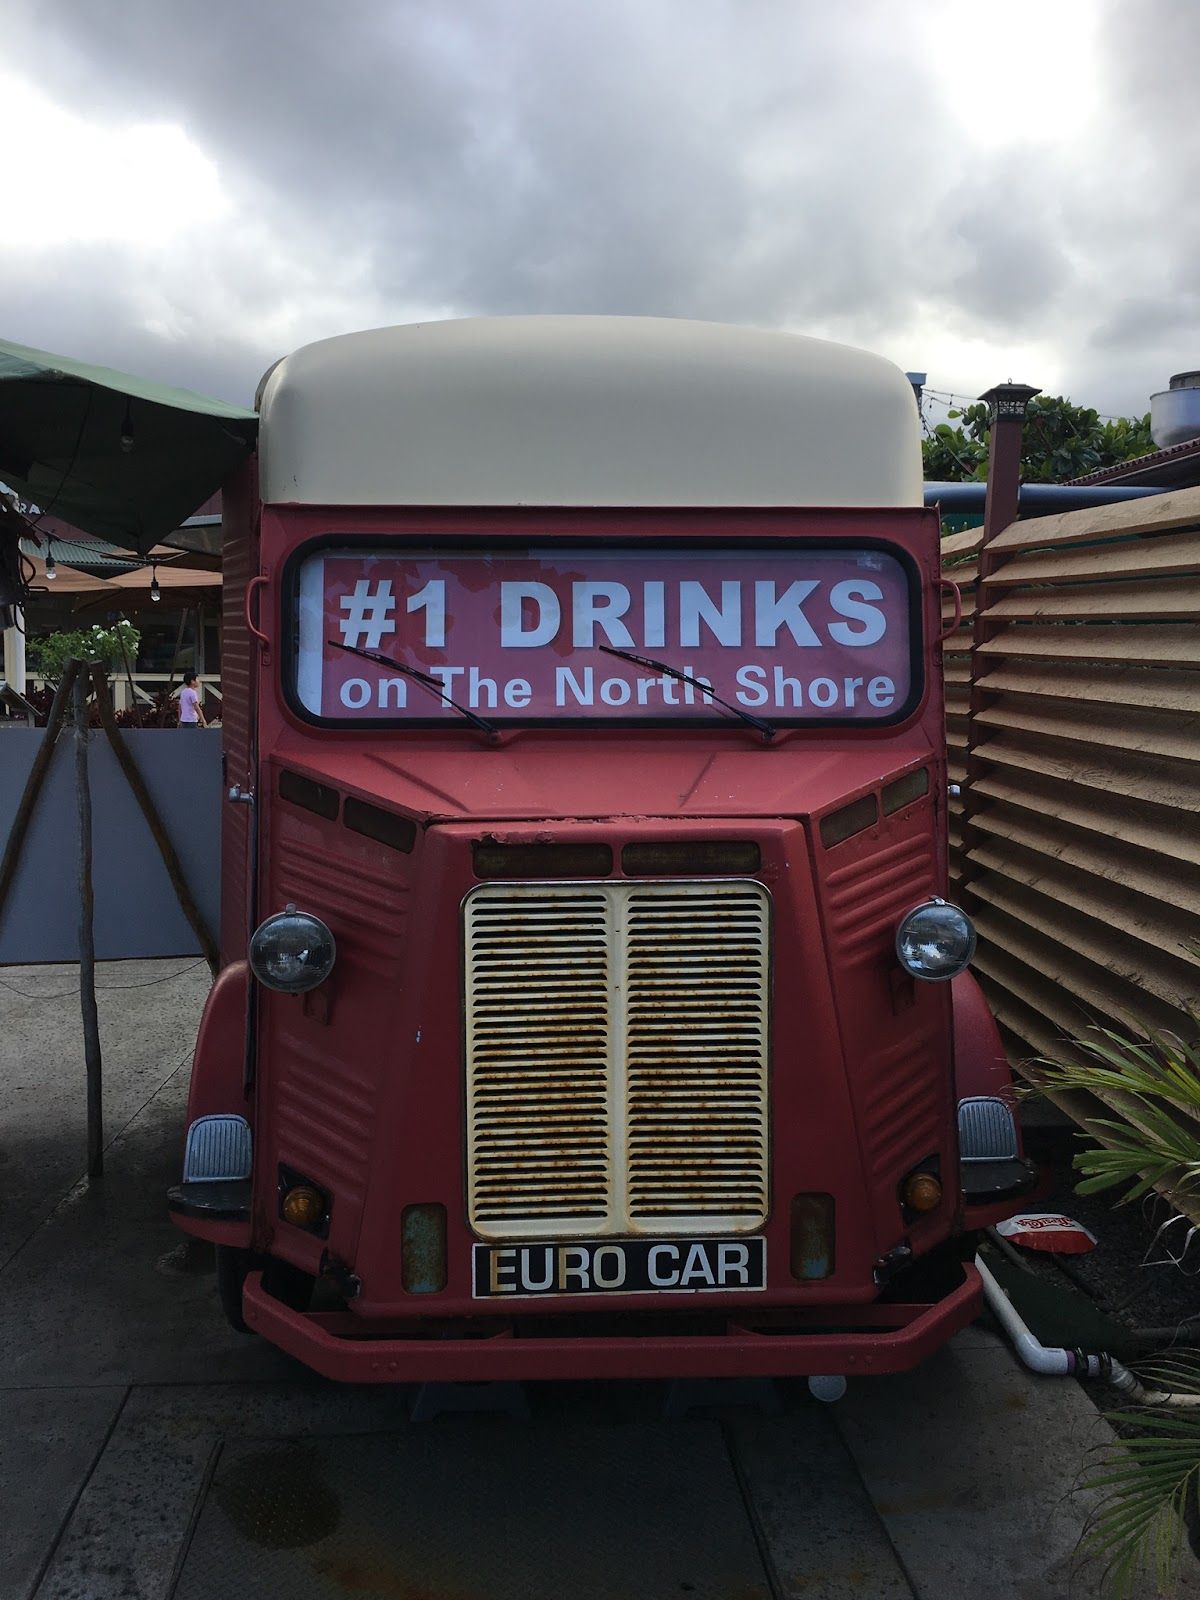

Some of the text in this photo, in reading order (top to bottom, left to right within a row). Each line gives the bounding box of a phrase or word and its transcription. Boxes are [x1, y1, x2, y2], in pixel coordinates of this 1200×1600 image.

[339, 579, 887, 648] #1 DRINKS
[340, 665, 896, 708] on The North Shore
[489, 1243, 750, 1292] EURO CAR
